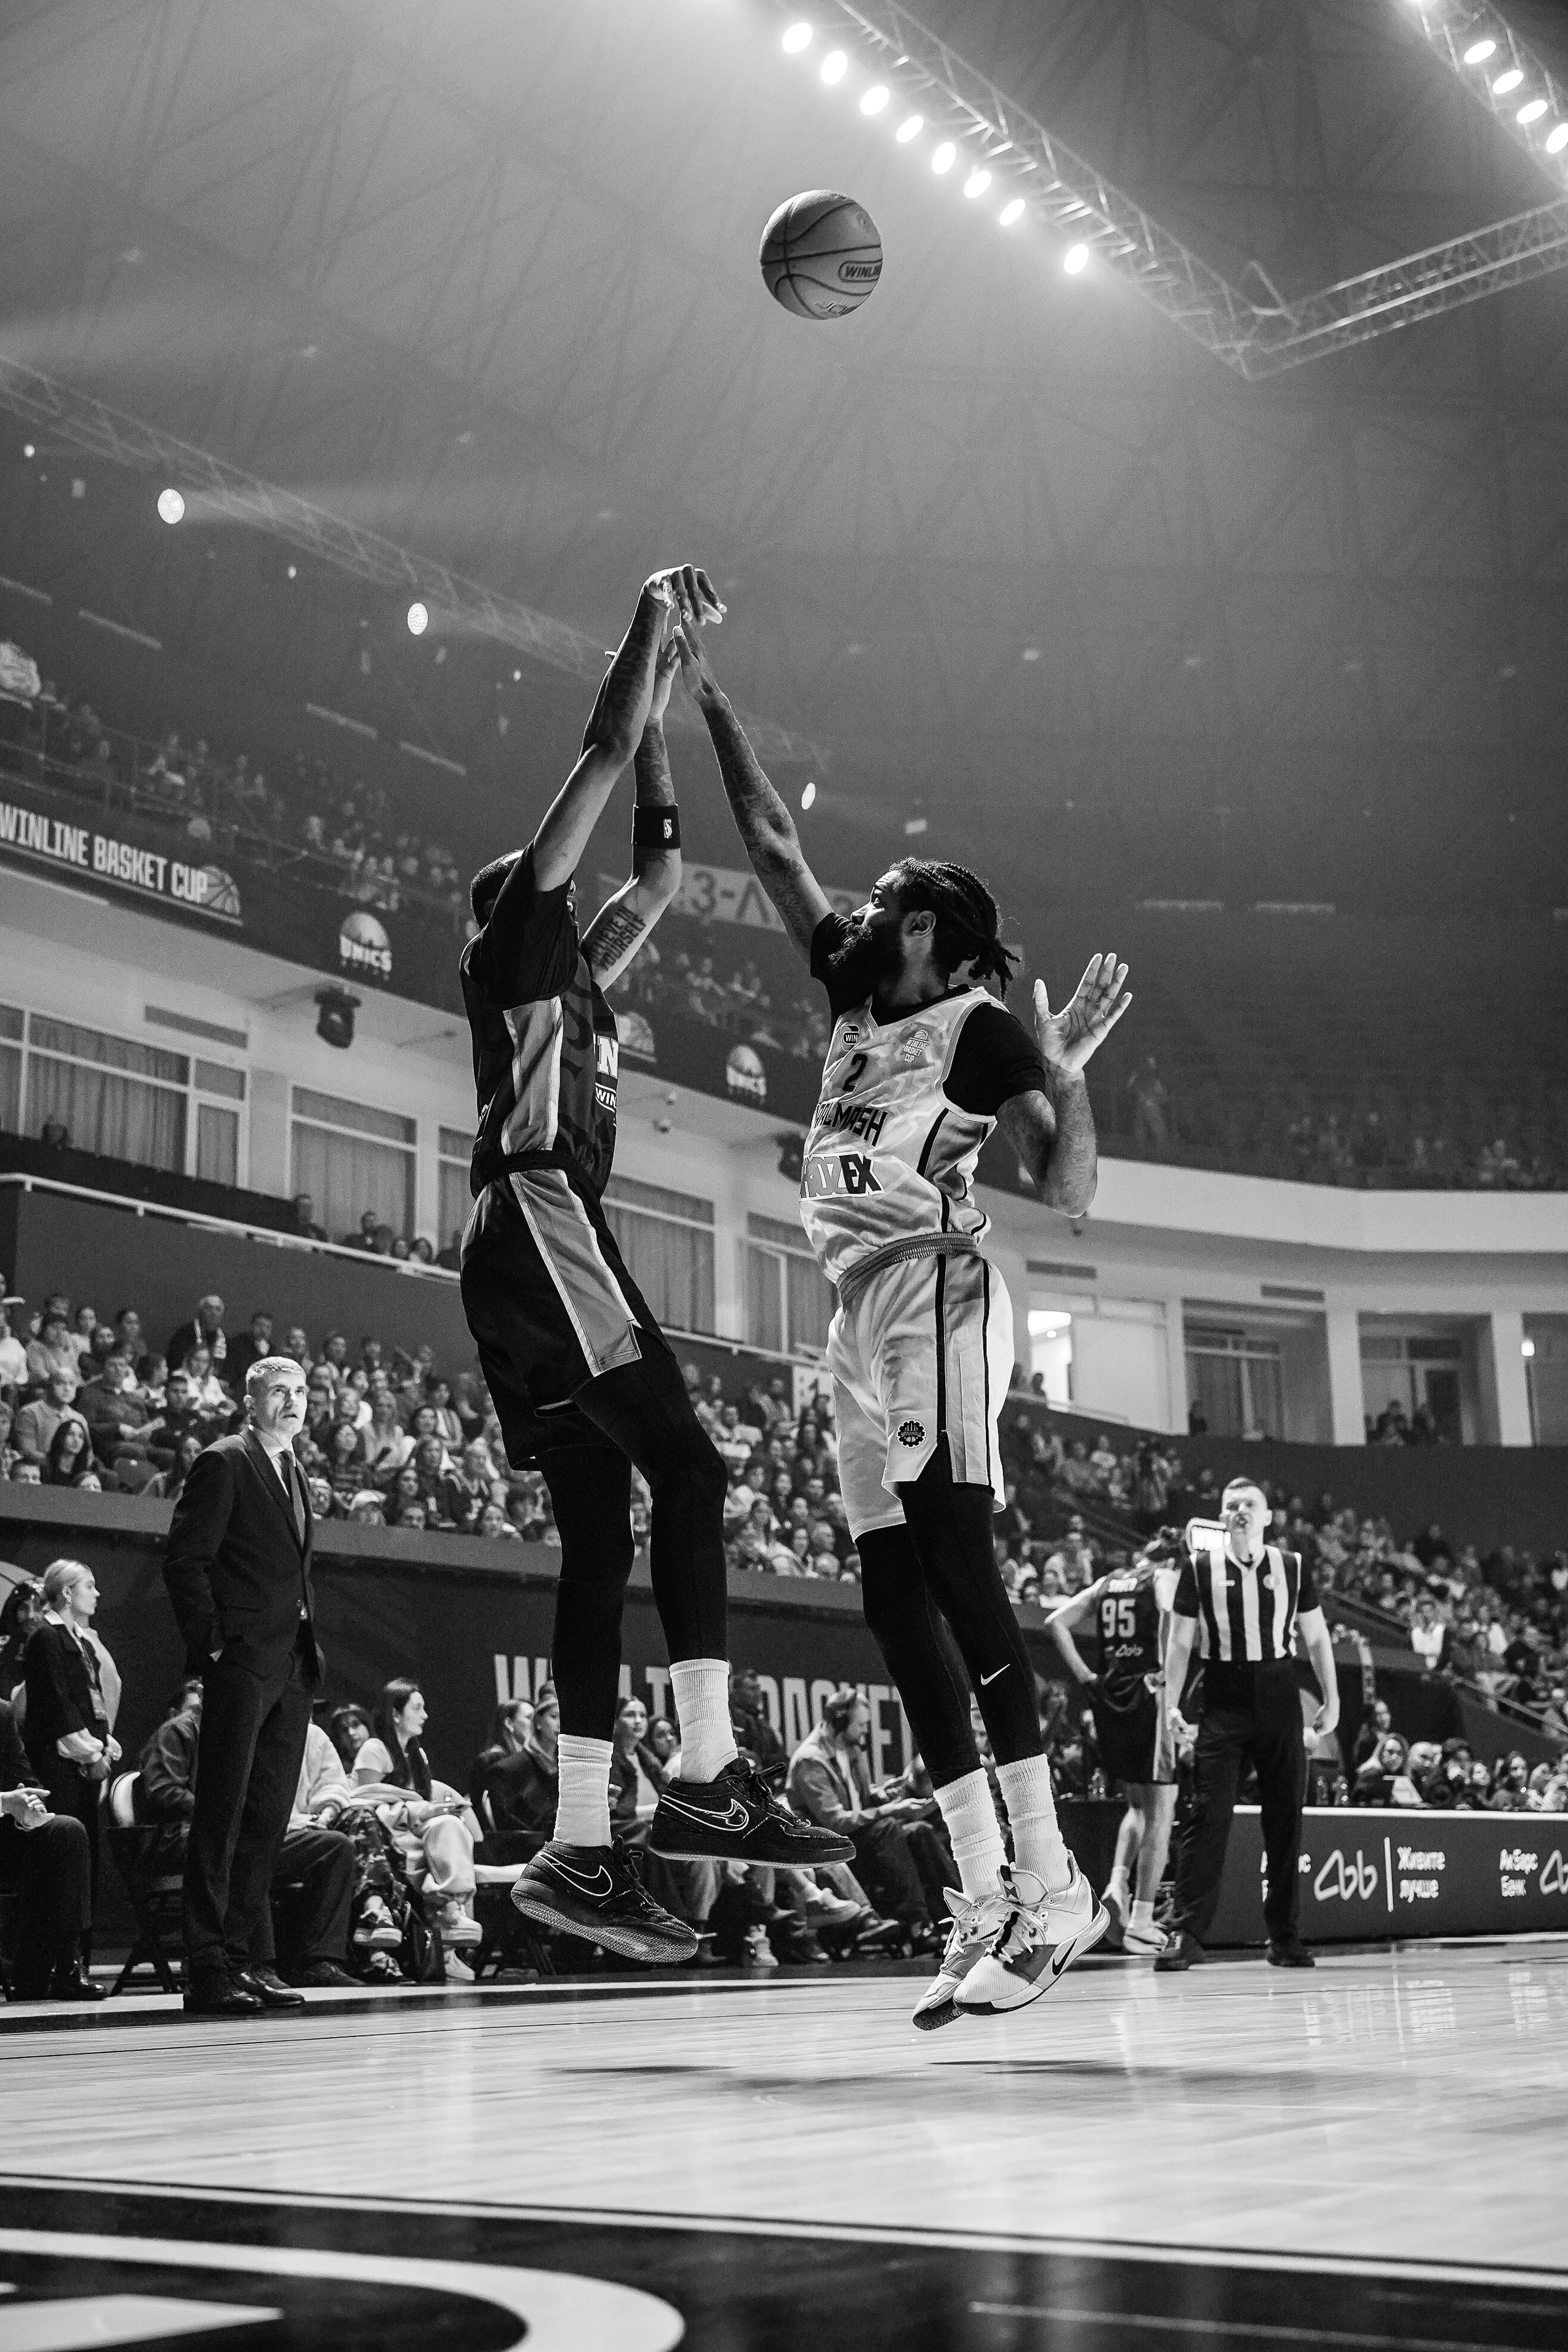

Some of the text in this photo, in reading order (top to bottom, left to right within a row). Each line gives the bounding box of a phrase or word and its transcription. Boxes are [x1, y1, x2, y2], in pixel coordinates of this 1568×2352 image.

[0, 801, 209, 903] WINLINE BASKET CUP
[596, 913, 647, 972] YOURSELF
[903, 1045, 923, 1057] BASKET
[904, 1053, 915, 1063] CUP
[842, 1053, 868, 1092] 2
[1102, 1598, 1136, 1638] 95
[1399, 1879, 1439, 1903] лучше
